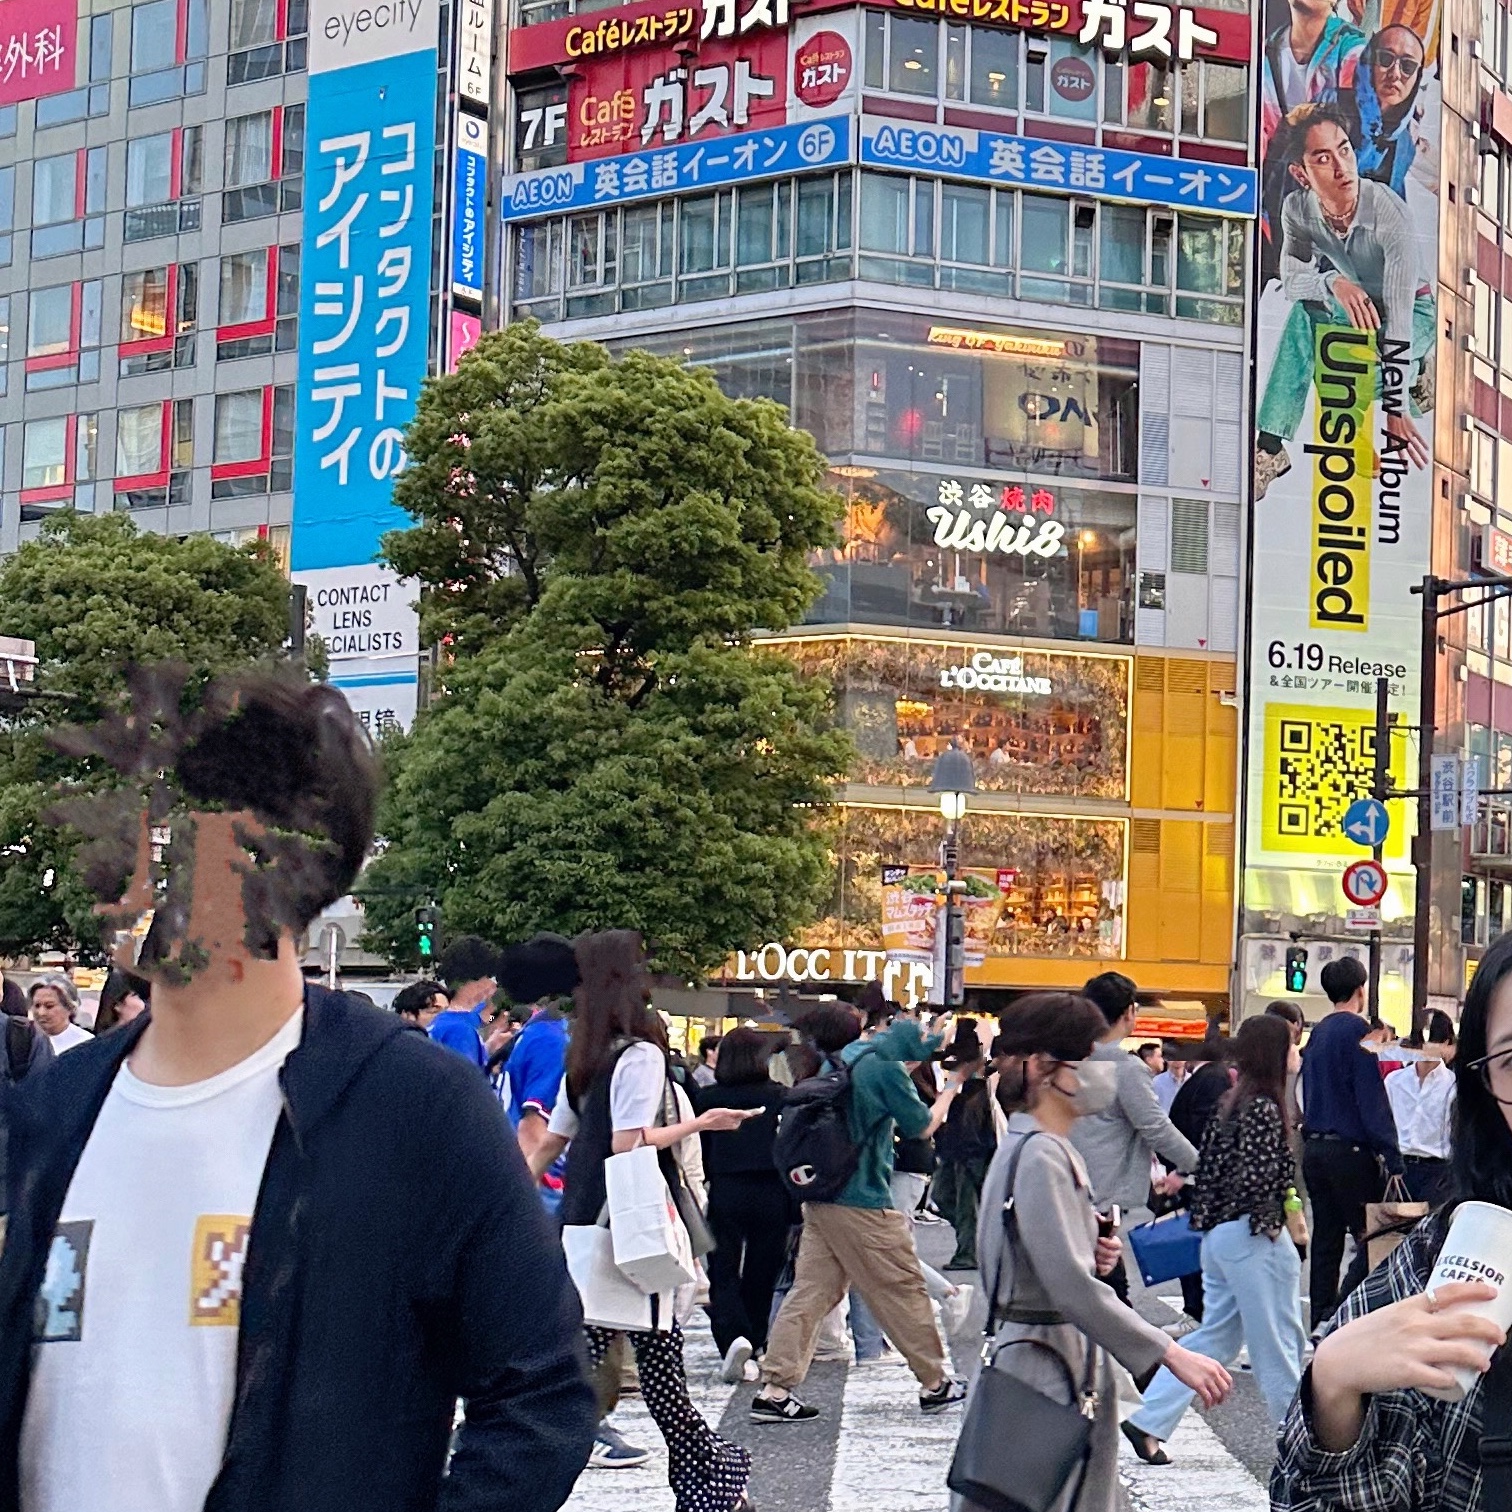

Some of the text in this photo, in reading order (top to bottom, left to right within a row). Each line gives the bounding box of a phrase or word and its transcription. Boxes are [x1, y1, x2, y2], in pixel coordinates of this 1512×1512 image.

[0, 24, 65, 84] 外科
[466, 0, 485, 77] ルーム
[566, 8, 694, 57] Caféレストラン
[1079, 0, 1218, 60] ガスト
[801, 62, 847, 88] ガスト
[521, 102, 567, 150] 7F
[580, 89, 636, 126] Café
[641, 61, 774, 146] ガスト
[580, 123, 634, 147] レストラン
[512, 131, 831, 209] AEON 英会話イーオン 6F
[874, 126, 1249, 204] AEON 英会話イーオン
[310, 130, 371, 487] アイシティ
[368, 121, 417, 478] コンタクトの
[1377, 337, 1411, 545] New Album
[1303, 330, 1369, 625] Unspoiled
[925, 505, 1065, 558] Ushi8
[317, 583, 391, 607] CONTACT
[333, 609, 373, 630] LENS
[324, 631, 403, 655] ECIALISTS
[1267, 639, 1407, 678] 6.19 Release
[1269, 674, 1407, 697] &全国ツアー開催定!
